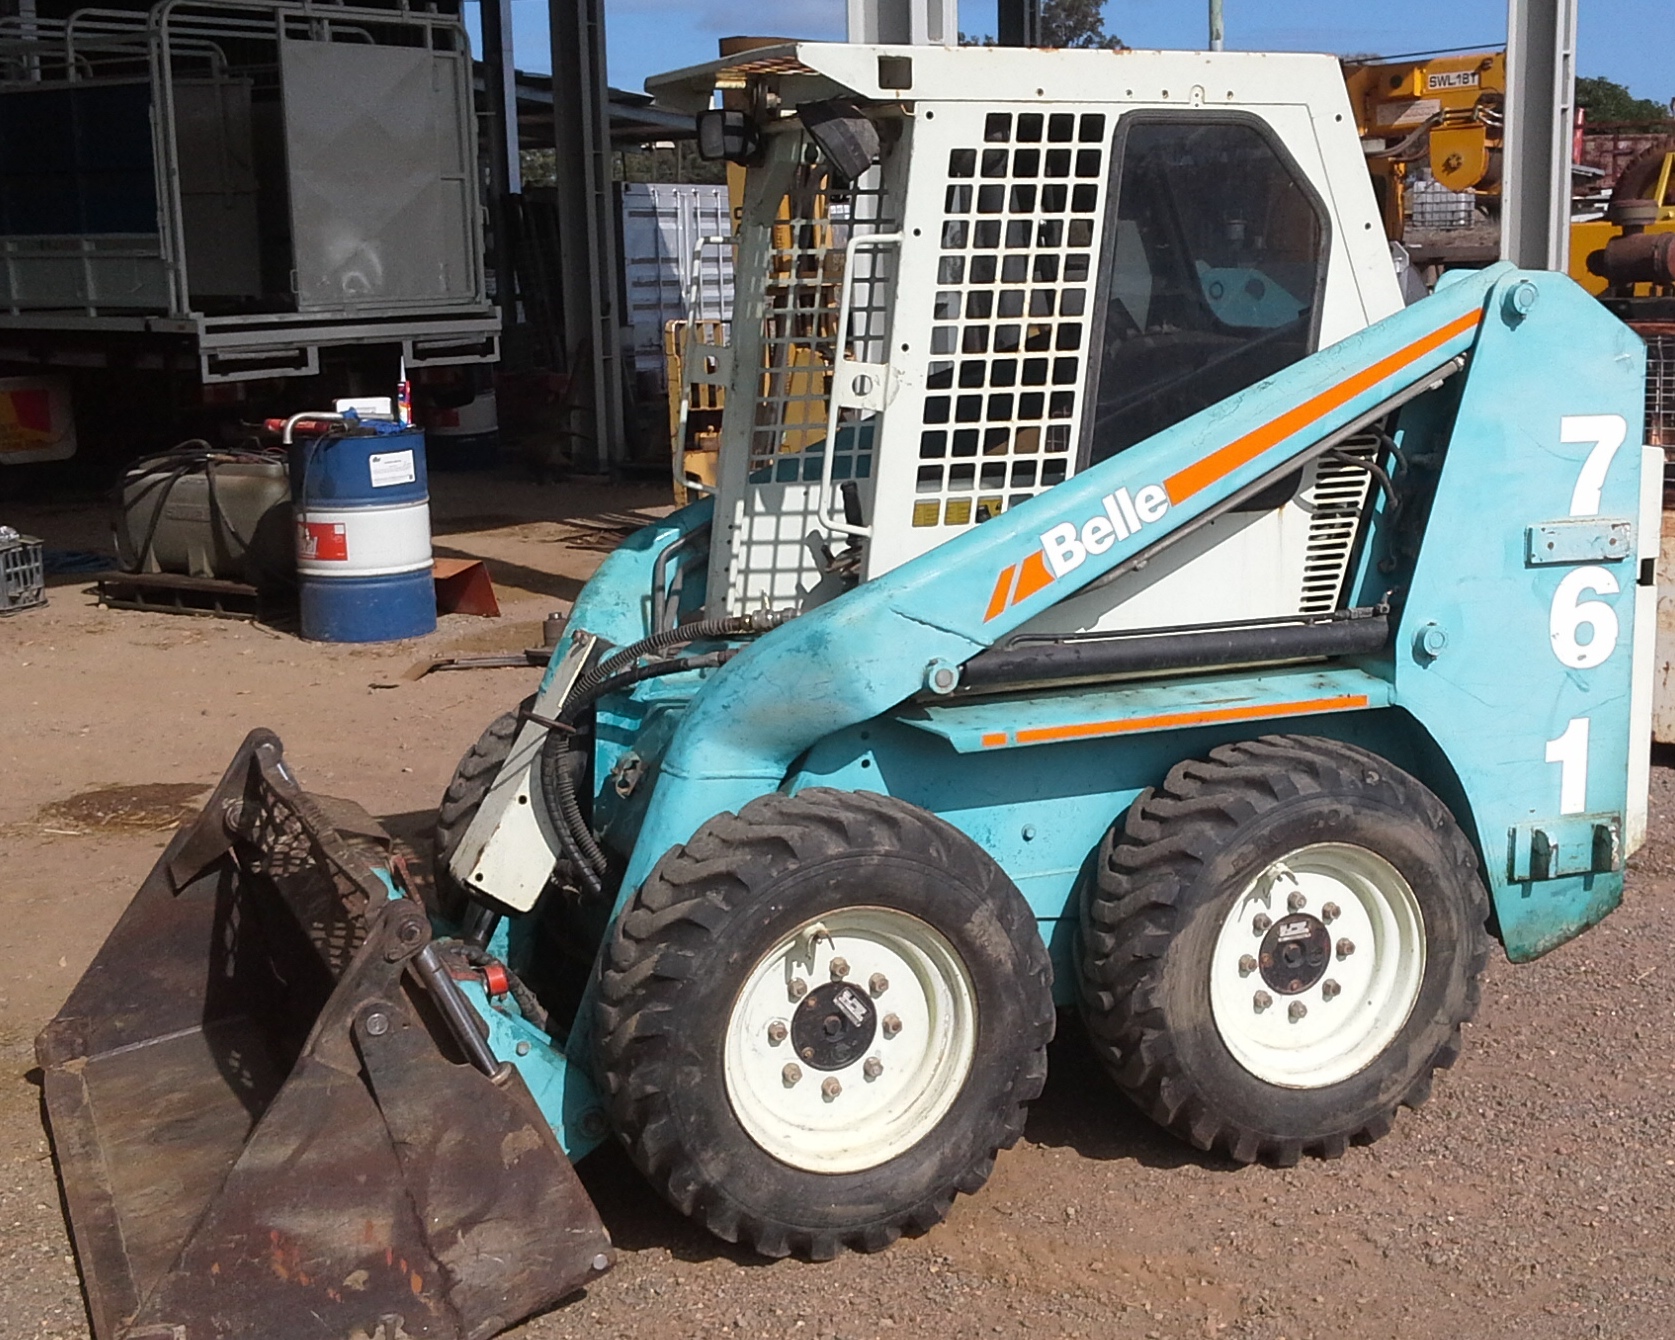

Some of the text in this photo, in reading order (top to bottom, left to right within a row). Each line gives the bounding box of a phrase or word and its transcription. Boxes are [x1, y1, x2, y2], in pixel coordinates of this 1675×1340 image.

[1560, 414, 1627, 517] 7
[1040, 484, 1170, 579] Belle
[1549, 565, 1620, 669] 6
[1545, 716, 1590, 815] 1
